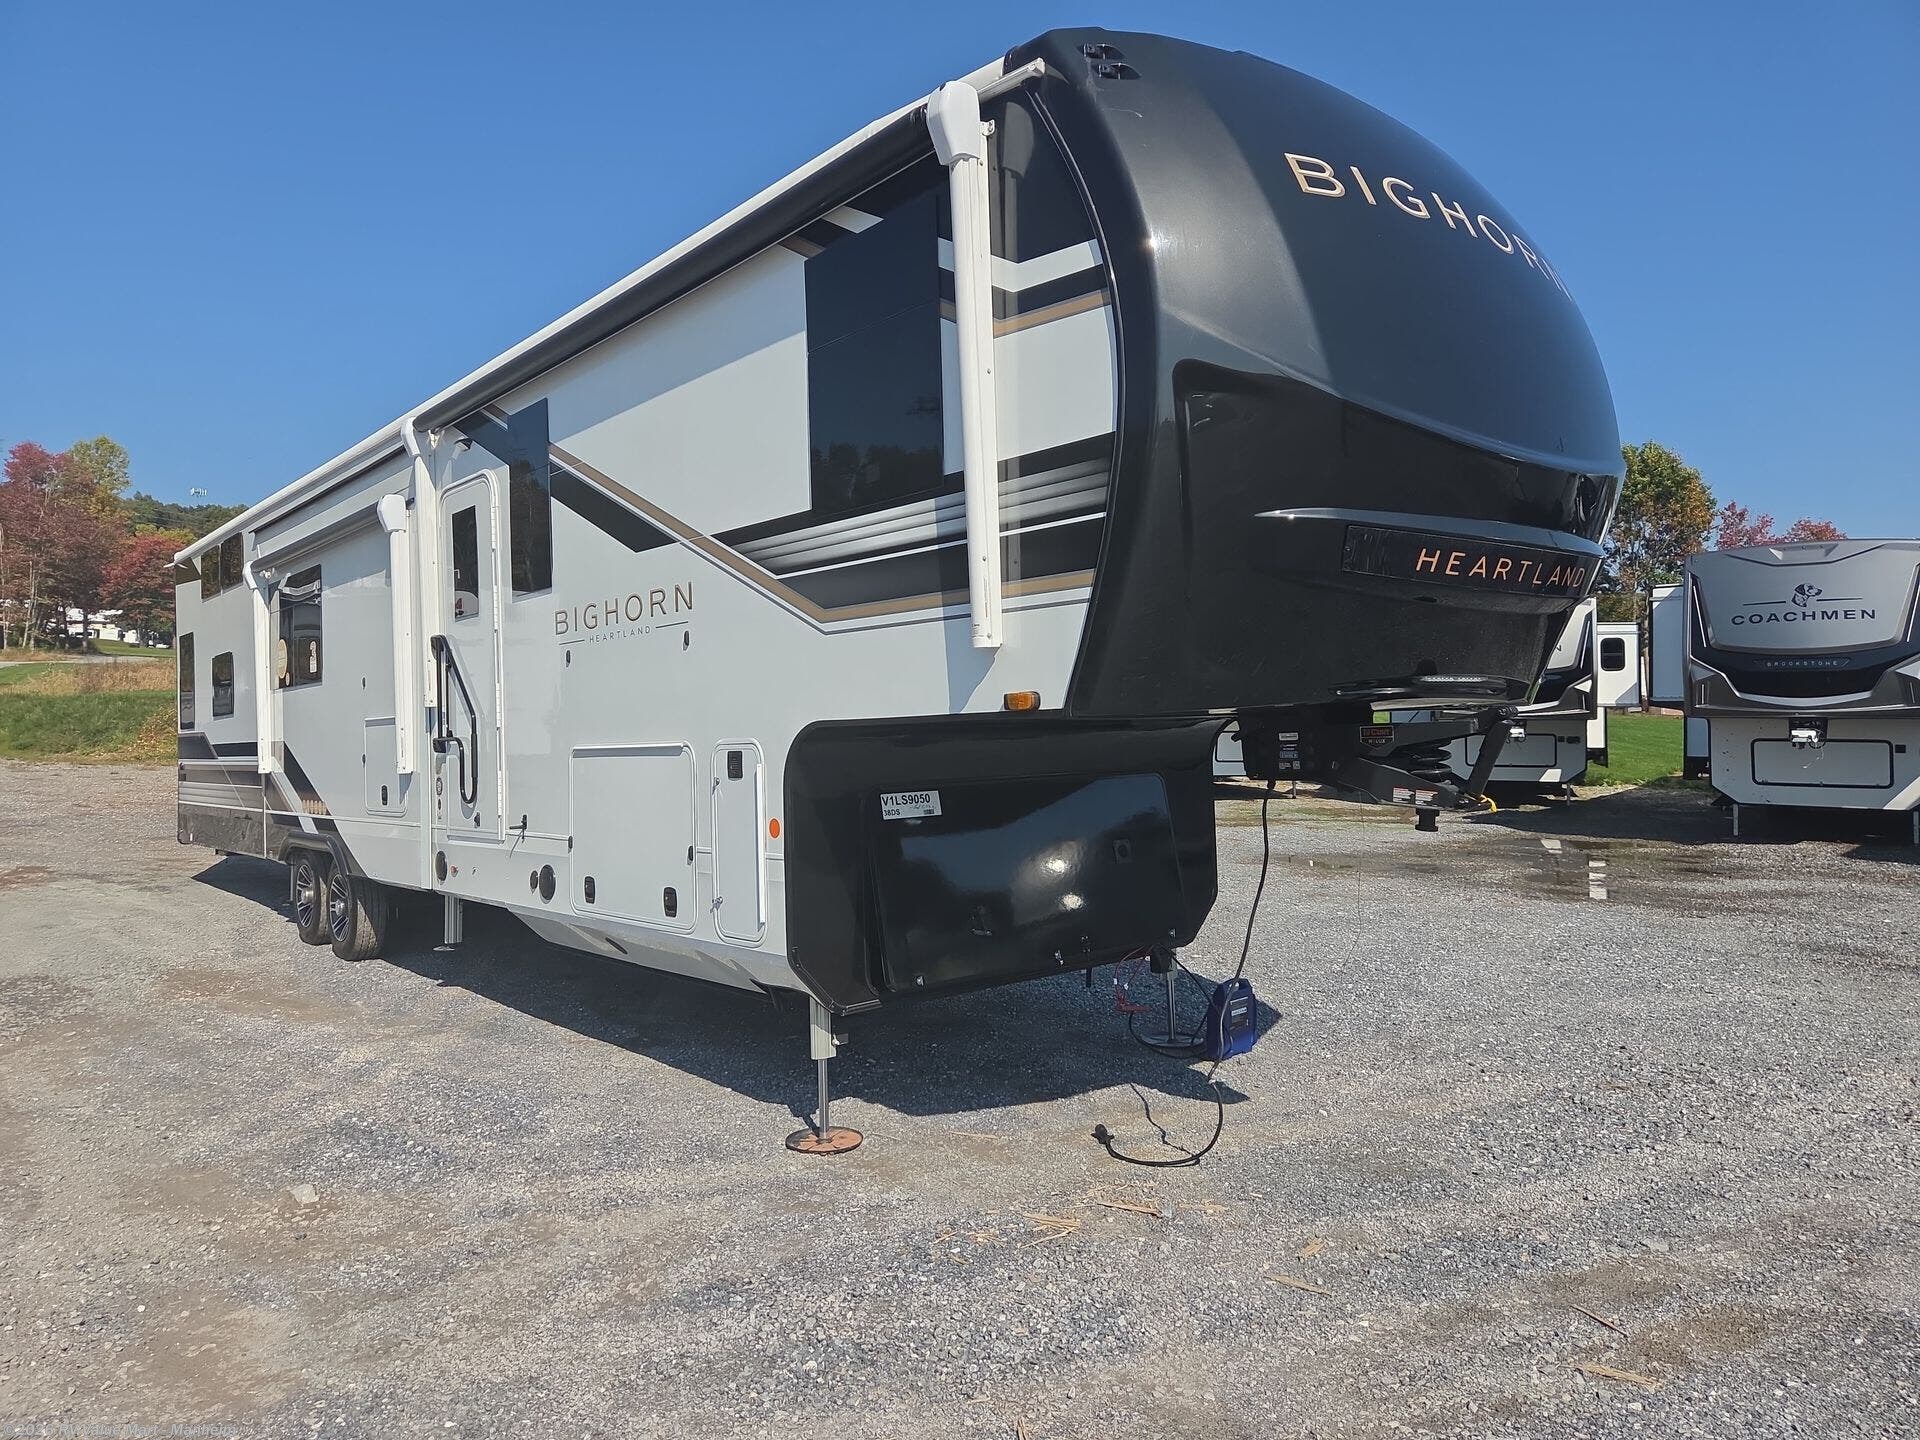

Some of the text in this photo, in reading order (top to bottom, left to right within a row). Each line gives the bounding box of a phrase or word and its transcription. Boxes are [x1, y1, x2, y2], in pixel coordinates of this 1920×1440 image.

[1284, 152, 1573, 302] BIGHORN
[1415, 548, 1585, 588] HEARTLAND
[554, 581, 693, 635] BIGHORN
[1730, 609, 1876, 626] COACHMEN
[589, 625, 651, 643] HEARTLAND
[881, 793, 931, 806] V1LS9050
[883, 809, 901, 817] 38DS
